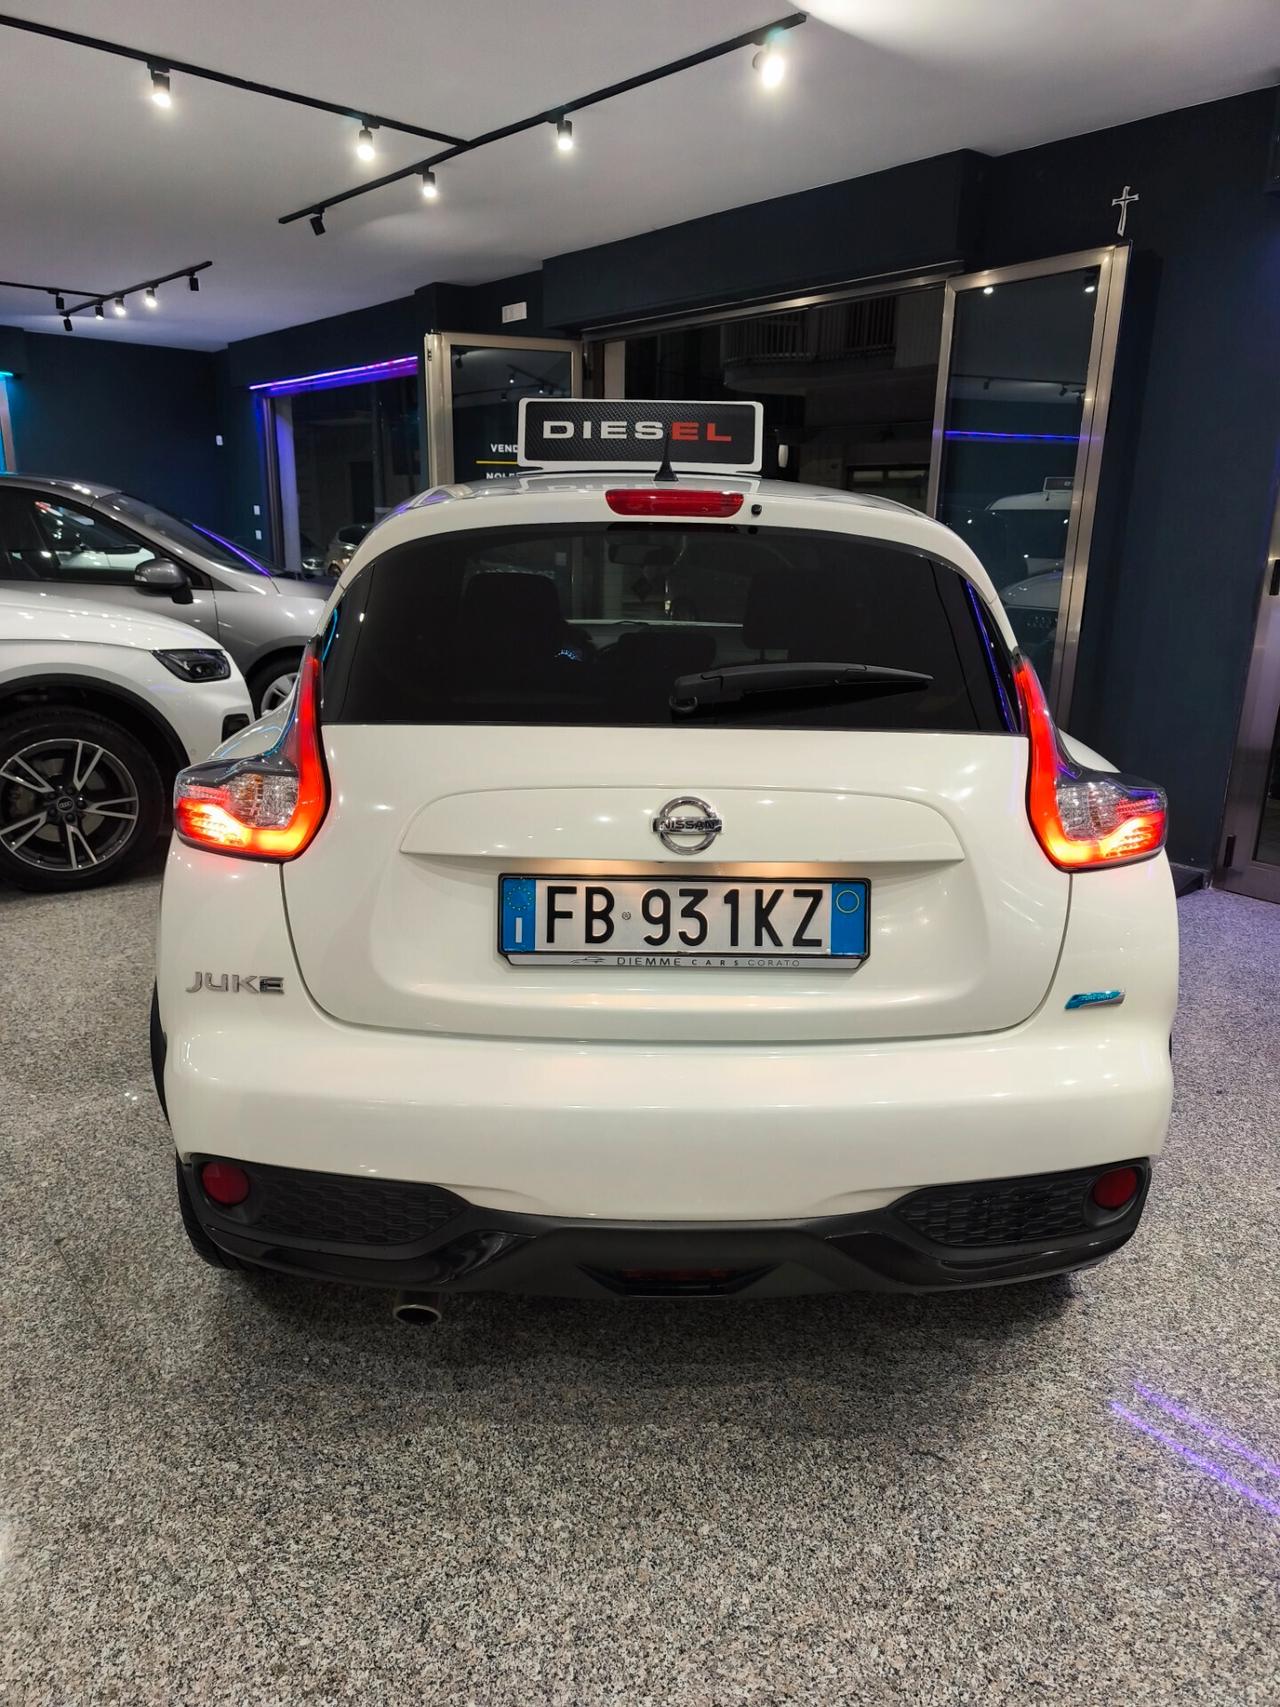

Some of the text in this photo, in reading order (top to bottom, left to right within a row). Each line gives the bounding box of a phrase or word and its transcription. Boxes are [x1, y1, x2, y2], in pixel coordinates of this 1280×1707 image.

[543, 420, 732, 442] DIESEL
[660, 820, 715, 831] NISSAN
[546, 886, 823, 946] FB 931KZ
[616, 957, 800, 968] DIEMME CARS CORATO
[185, 971, 285, 995] JUKE
